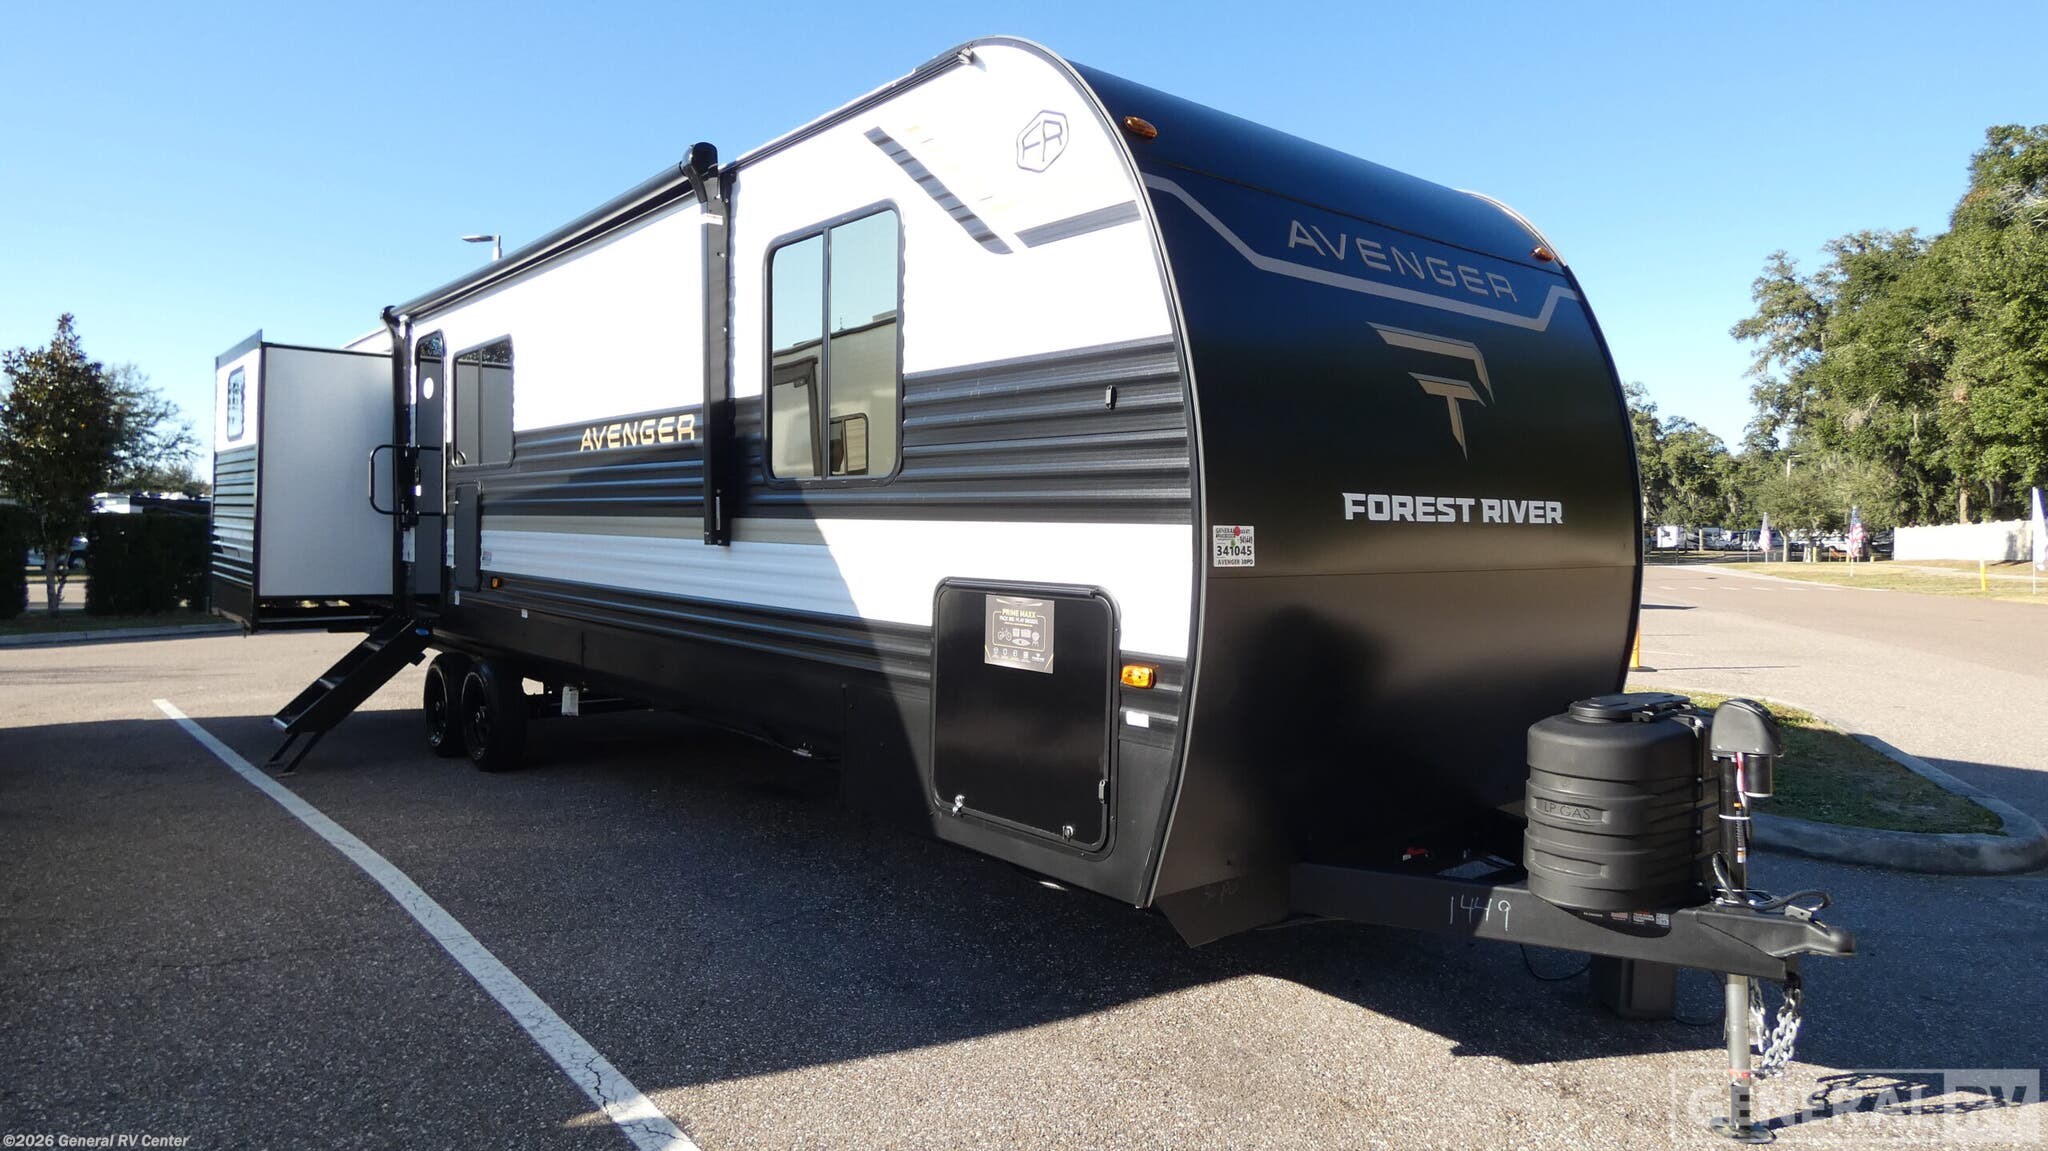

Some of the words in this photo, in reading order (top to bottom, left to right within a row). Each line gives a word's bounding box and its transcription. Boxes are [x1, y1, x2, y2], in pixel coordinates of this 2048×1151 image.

[1288, 219, 1518, 303] AVENGER
[580, 413, 695, 452] AVENGER
[1342, 492, 1475, 523] FOREST
[1480, 498, 1563, 524] RIVER
[1217, 546, 1252, 556] 341045
[1544, 801, 1557, 814] LP
[1560, 805, 1591, 820] GAS
[1450, 895, 1511, 931] 1449
